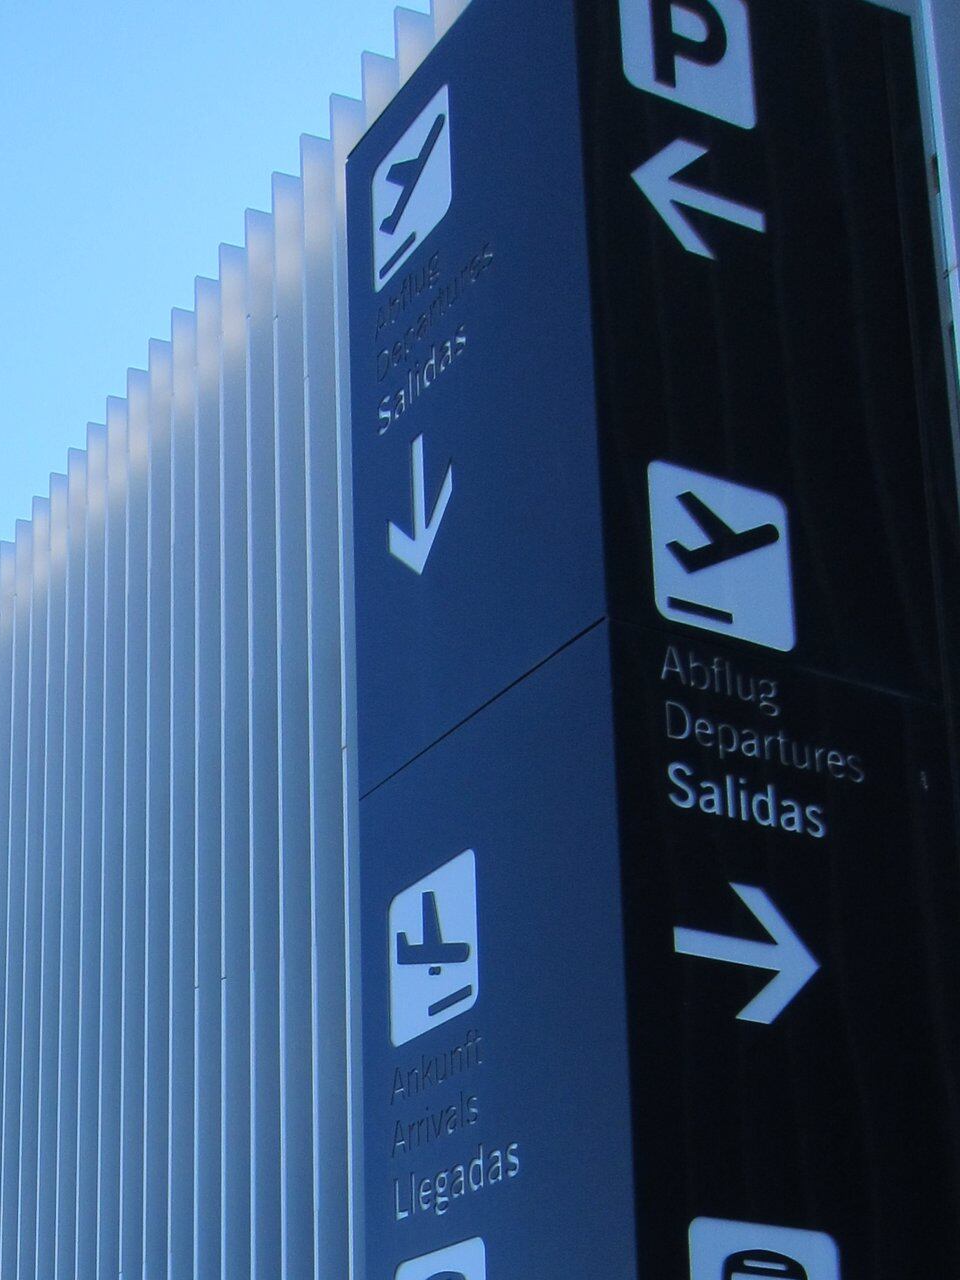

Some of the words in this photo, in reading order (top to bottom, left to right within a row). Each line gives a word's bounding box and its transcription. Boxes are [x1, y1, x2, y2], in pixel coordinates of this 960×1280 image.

[377, 241, 493, 384] Departures
[378, 324, 467, 436] Salidas
[661, 645, 781, 717] Abflug
[665, 700, 864, 783] Departures
[667, 761, 827, 839] Salidas
[390, 1029, 483, 1106] Ankunft
[392, 1091, 479, 1158] Arrivals
[395, 1142, 520, 1221] Llegadas
